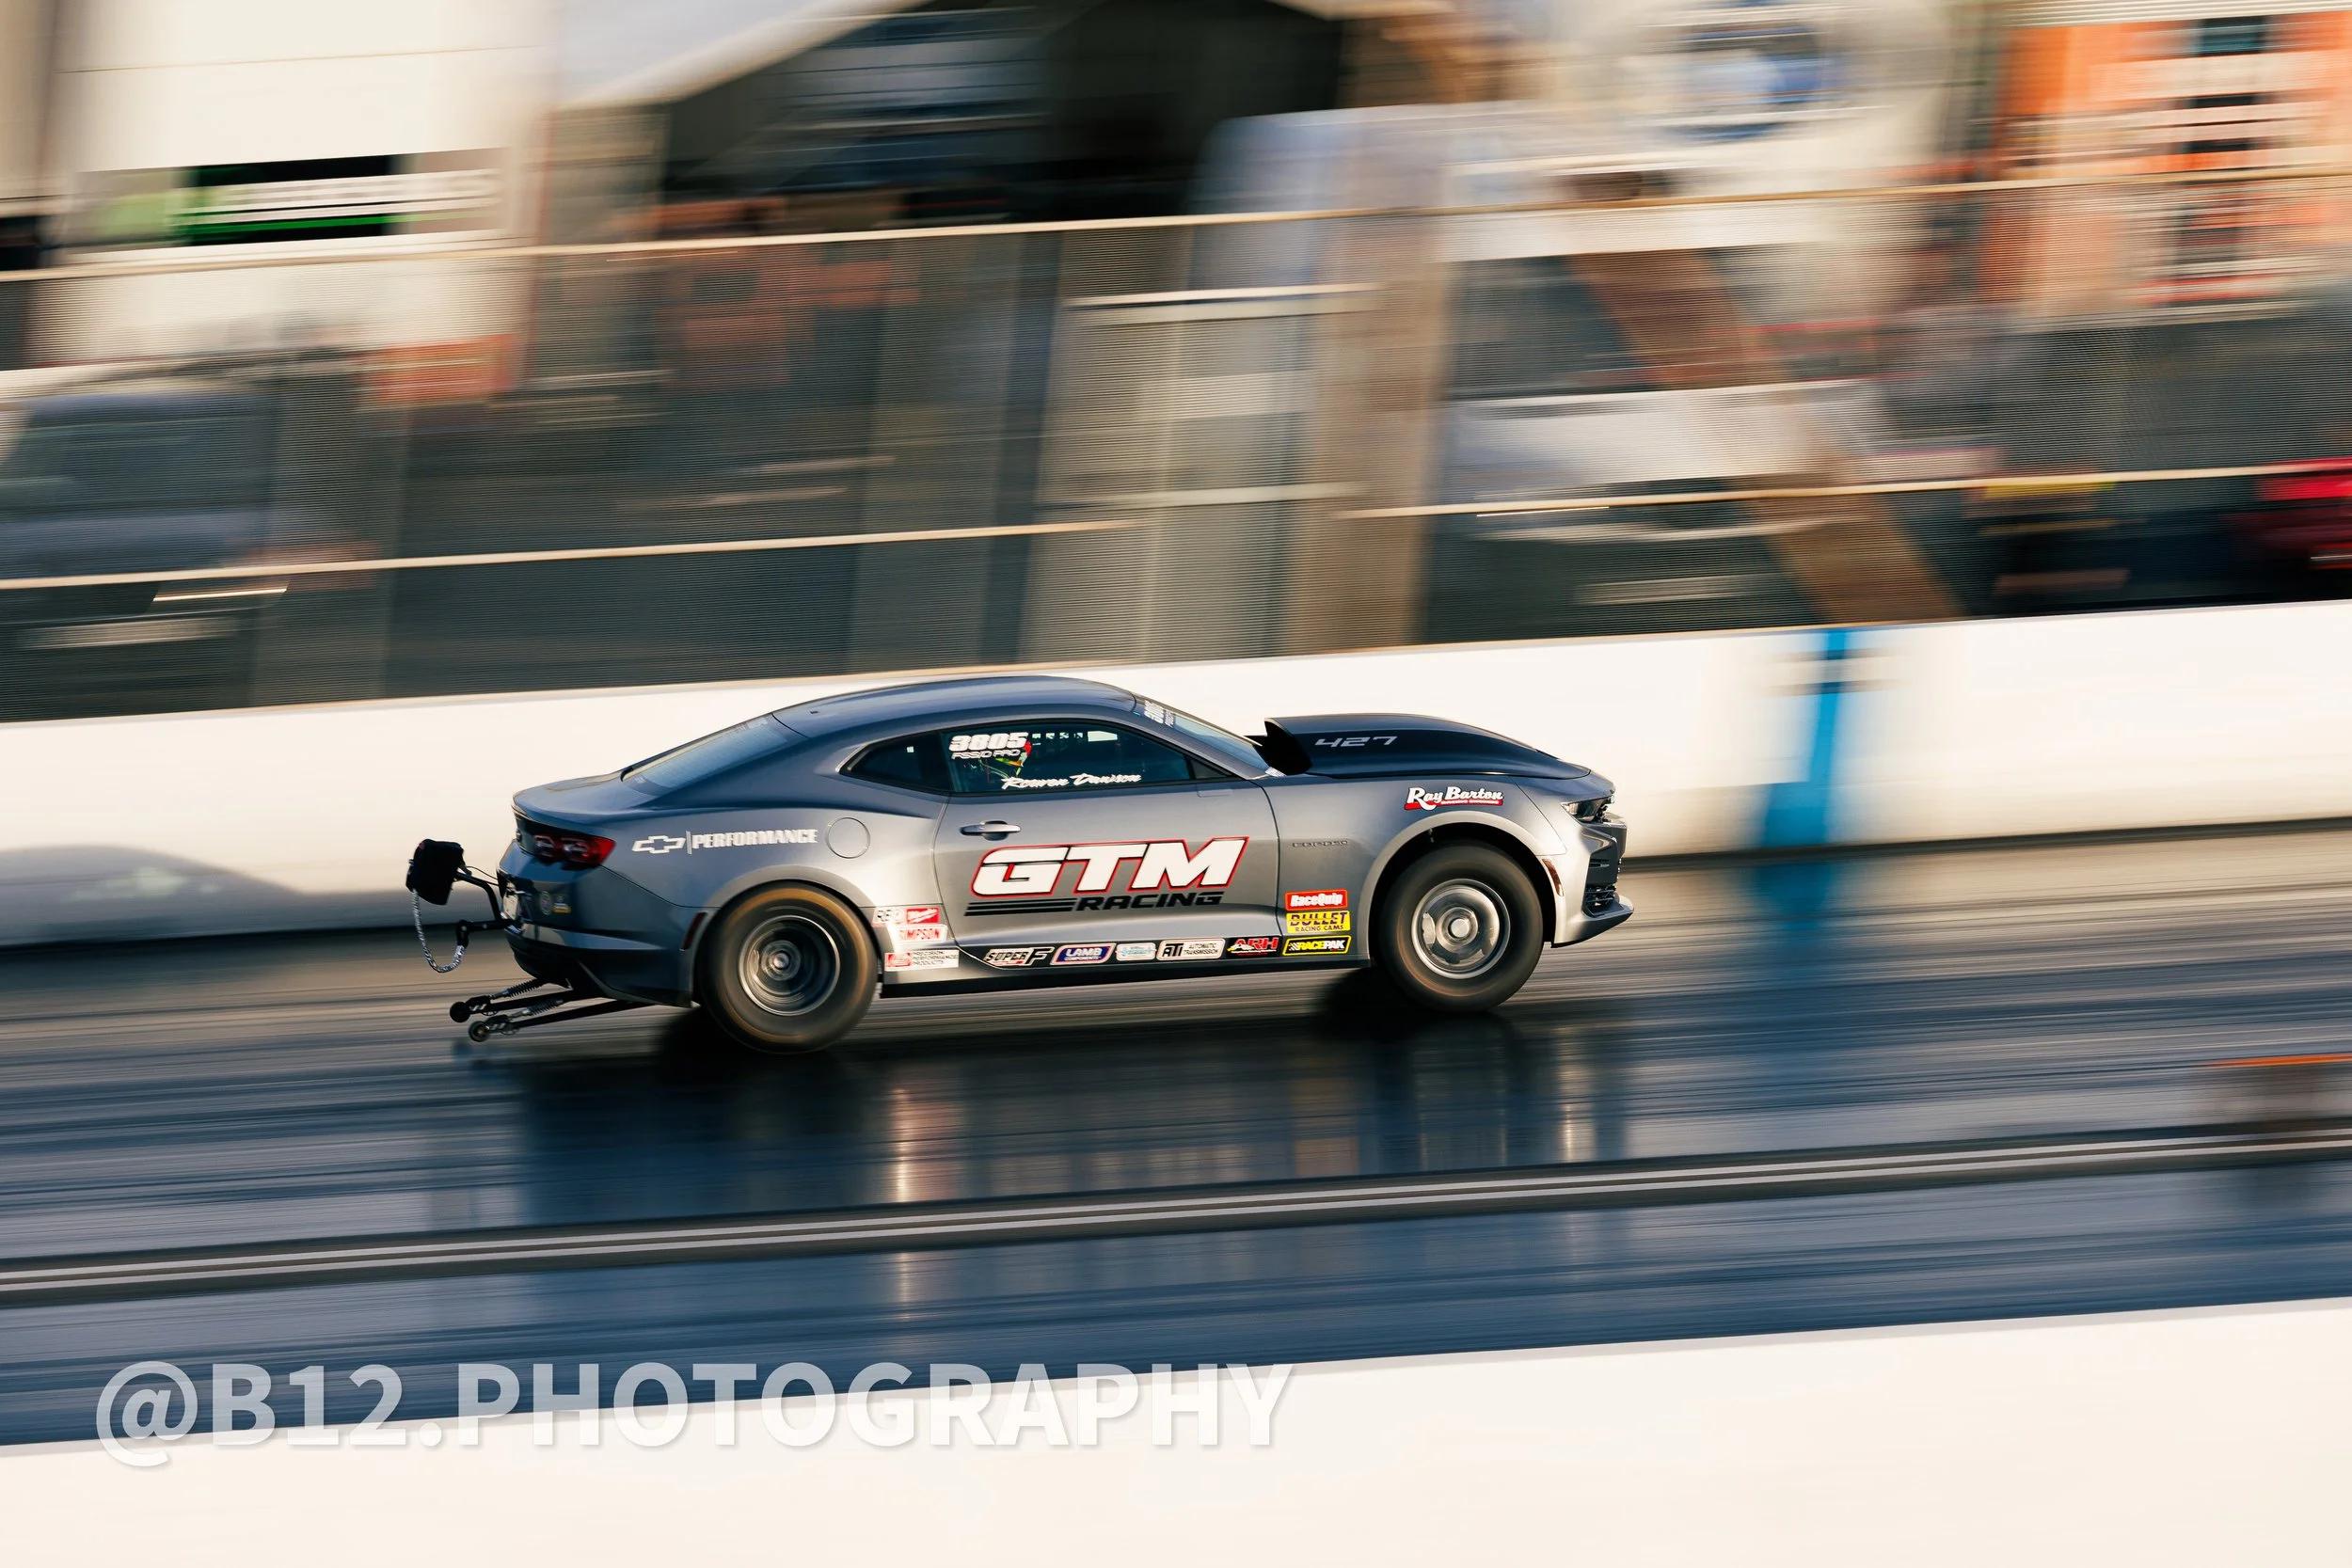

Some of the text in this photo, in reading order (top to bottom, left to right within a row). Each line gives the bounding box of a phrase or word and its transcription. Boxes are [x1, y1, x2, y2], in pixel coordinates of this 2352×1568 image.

[1315, 736, 1397, 748] 427
[1406, 785, 1504, 810] Ray Barton
[691, 829, 818, 849] PERFORMANCE
[971, 836, 1249, 898] GTM
[1075, 890, 1225, 911] RACING
[1290, 892, 1343, 908] RaceQuip
[1290, 911, 1348, 927] BULLET
[1066, 947, 1103, 958] LAMB
[1162, 942, 1184, 958] ATI
[1232, 937, 1279, 952] ARH
[1297, 940, 1346, 951] RACEPAK
[985, 946, 1055, 966] SUPER F
